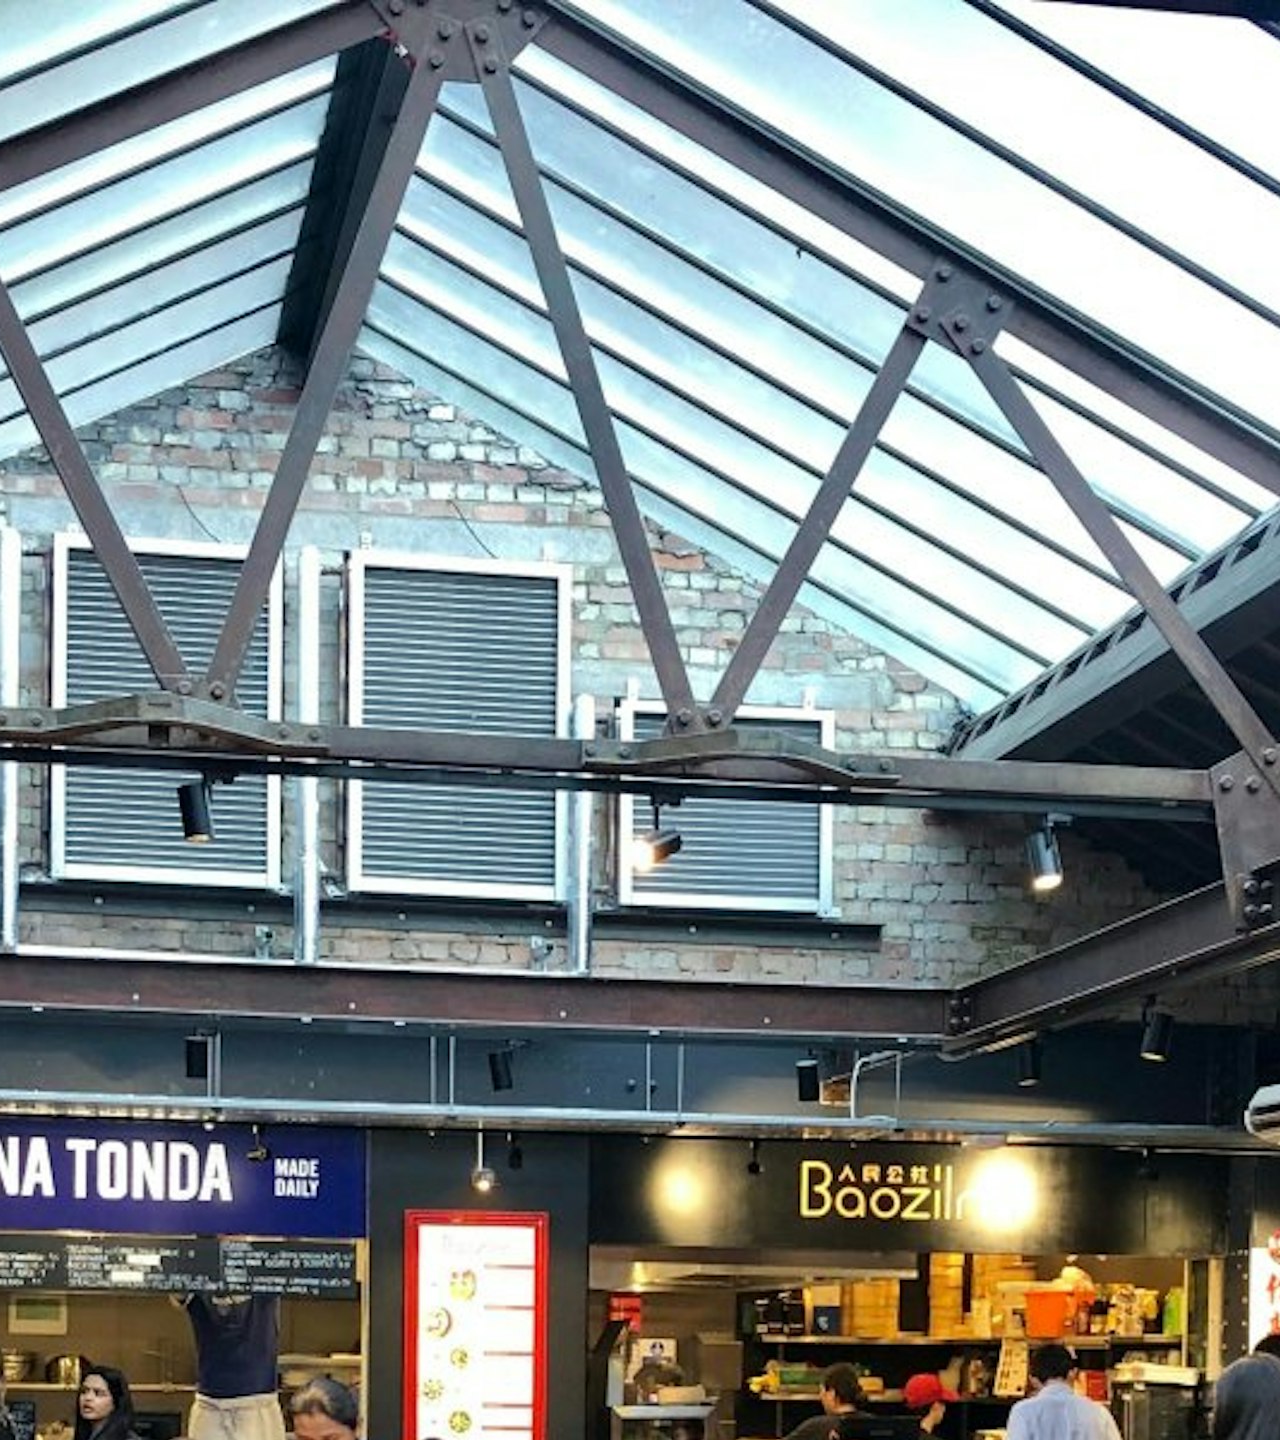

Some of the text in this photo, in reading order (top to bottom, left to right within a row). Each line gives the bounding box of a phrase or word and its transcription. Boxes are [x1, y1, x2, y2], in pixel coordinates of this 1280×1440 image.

[65, 1138, 233, 1202] TONDA
[274, 1157, 320, 1178] MADE
[274, 1178, 320, 1198] DAILY
